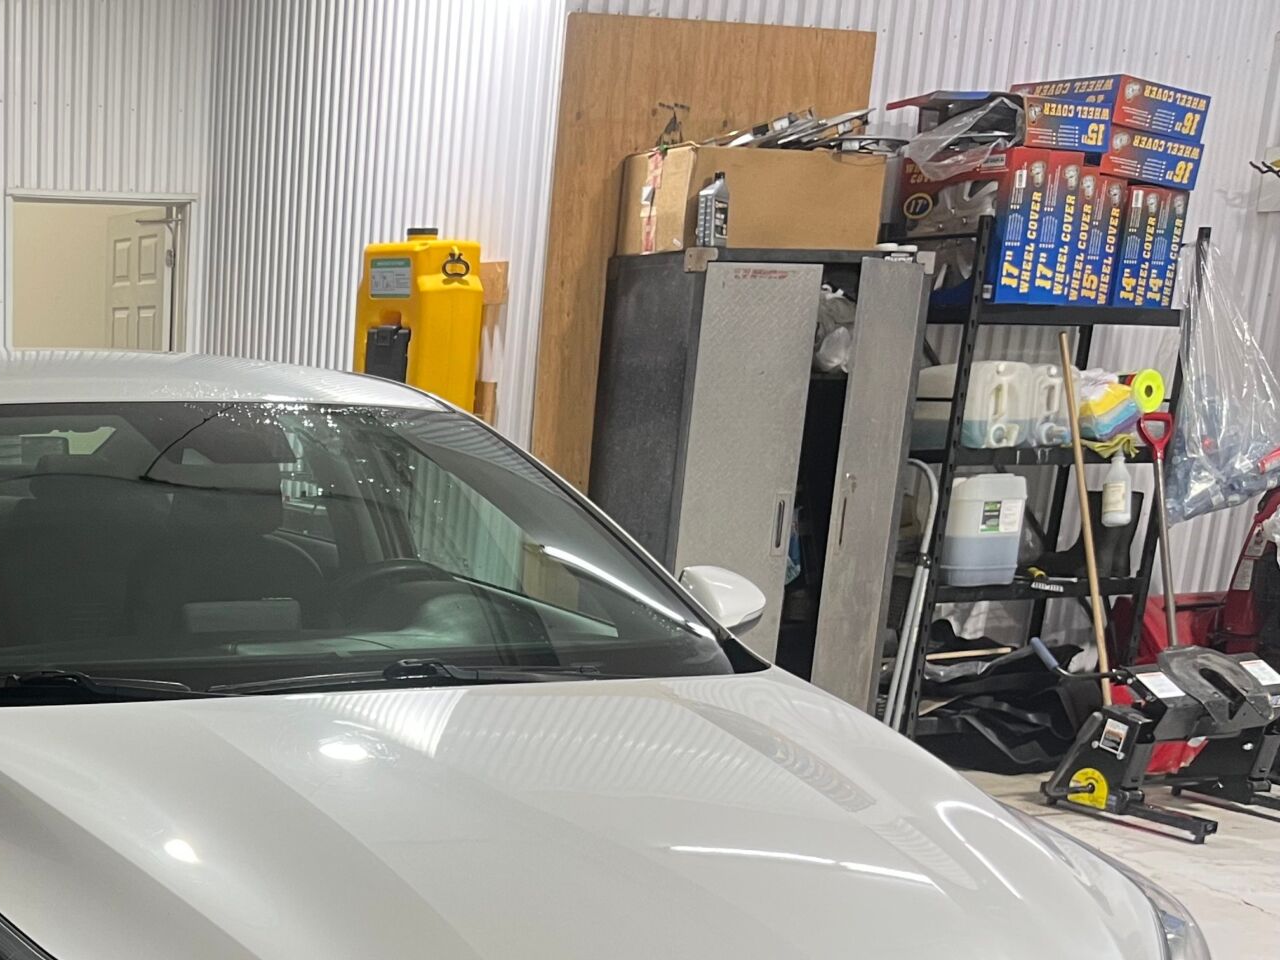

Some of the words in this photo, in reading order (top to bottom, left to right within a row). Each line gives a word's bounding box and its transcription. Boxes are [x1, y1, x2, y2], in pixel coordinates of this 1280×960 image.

[1033, 82, 1071, 97] COVER
[1073, 78, 1114, 94] WHEEL
[1143, 84, 1174, 103] COVER
[1043, 102, 1075, 118] COVER
[1176, 93, 1207, 111] WHEEL
[1076, 105, 1109, 121] WHEEL
[1132, 135, 1166, 152] COVER
[1166, 142, 1200, 160] WHEEL
[1027, 191, 1043, 240] COVER
[1052, 245, 1069, 296] WHEEL
[1061, 194, 1076, 243] COVER
[1068, 252, 1085, 301] WHEEL
[1077, 203, 1093, 250] COVER
[1097, 256, 1113, 305] WHEEL
[1105, 207, 1121, 254] COVER
[1134, 261, 1149, 306] WHEEL
[1142, 216, 1157, 259] COVER
[1161, 262, 1176, 307] WHEEL
[1169, 218, 1184, 260] COVER
[1019, 243, 1036, 294] WHEEL
